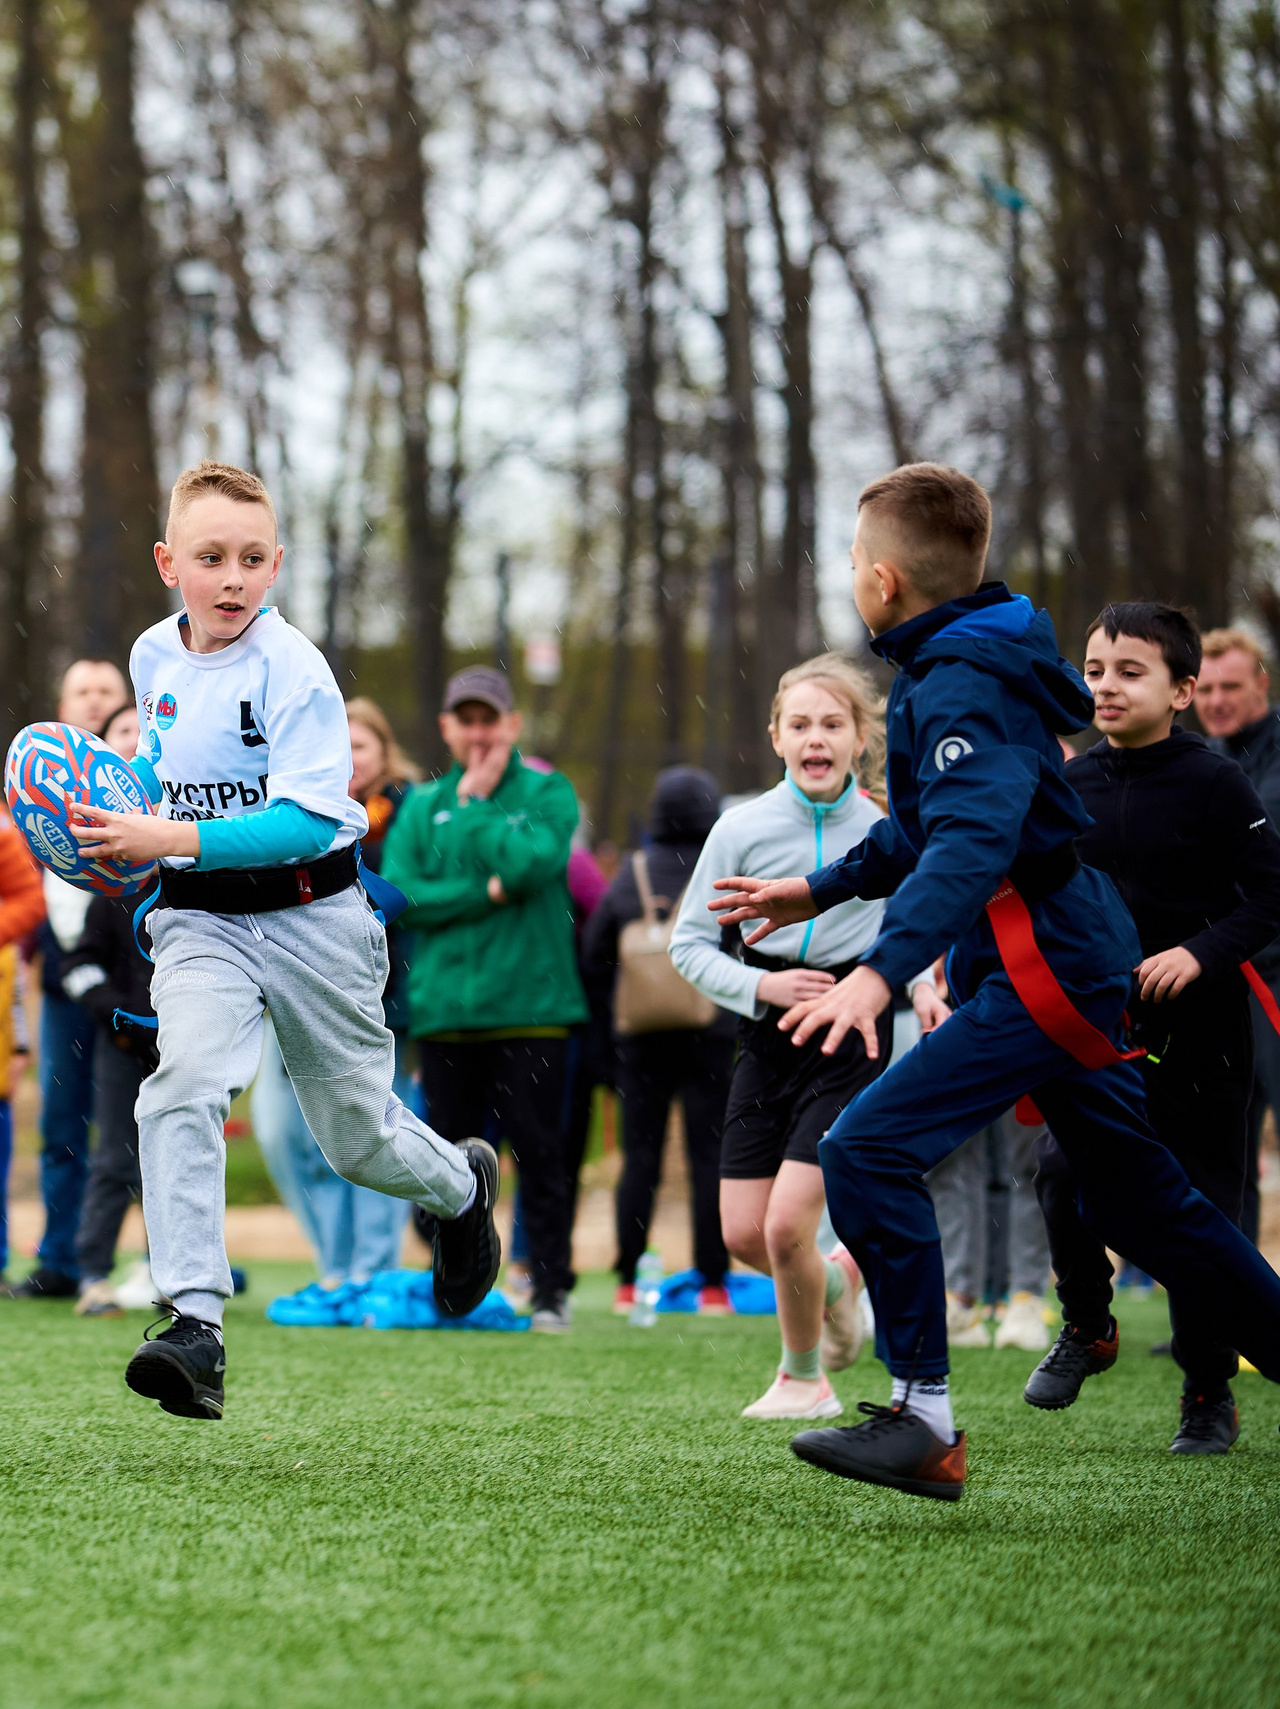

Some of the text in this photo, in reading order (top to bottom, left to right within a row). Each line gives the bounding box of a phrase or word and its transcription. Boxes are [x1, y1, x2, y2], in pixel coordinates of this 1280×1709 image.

[112, 767, 142, 807] РЕГБИ
[30, 835, 50, 857] ПРО
[42, 820, 76, 859] РЕГБИ
